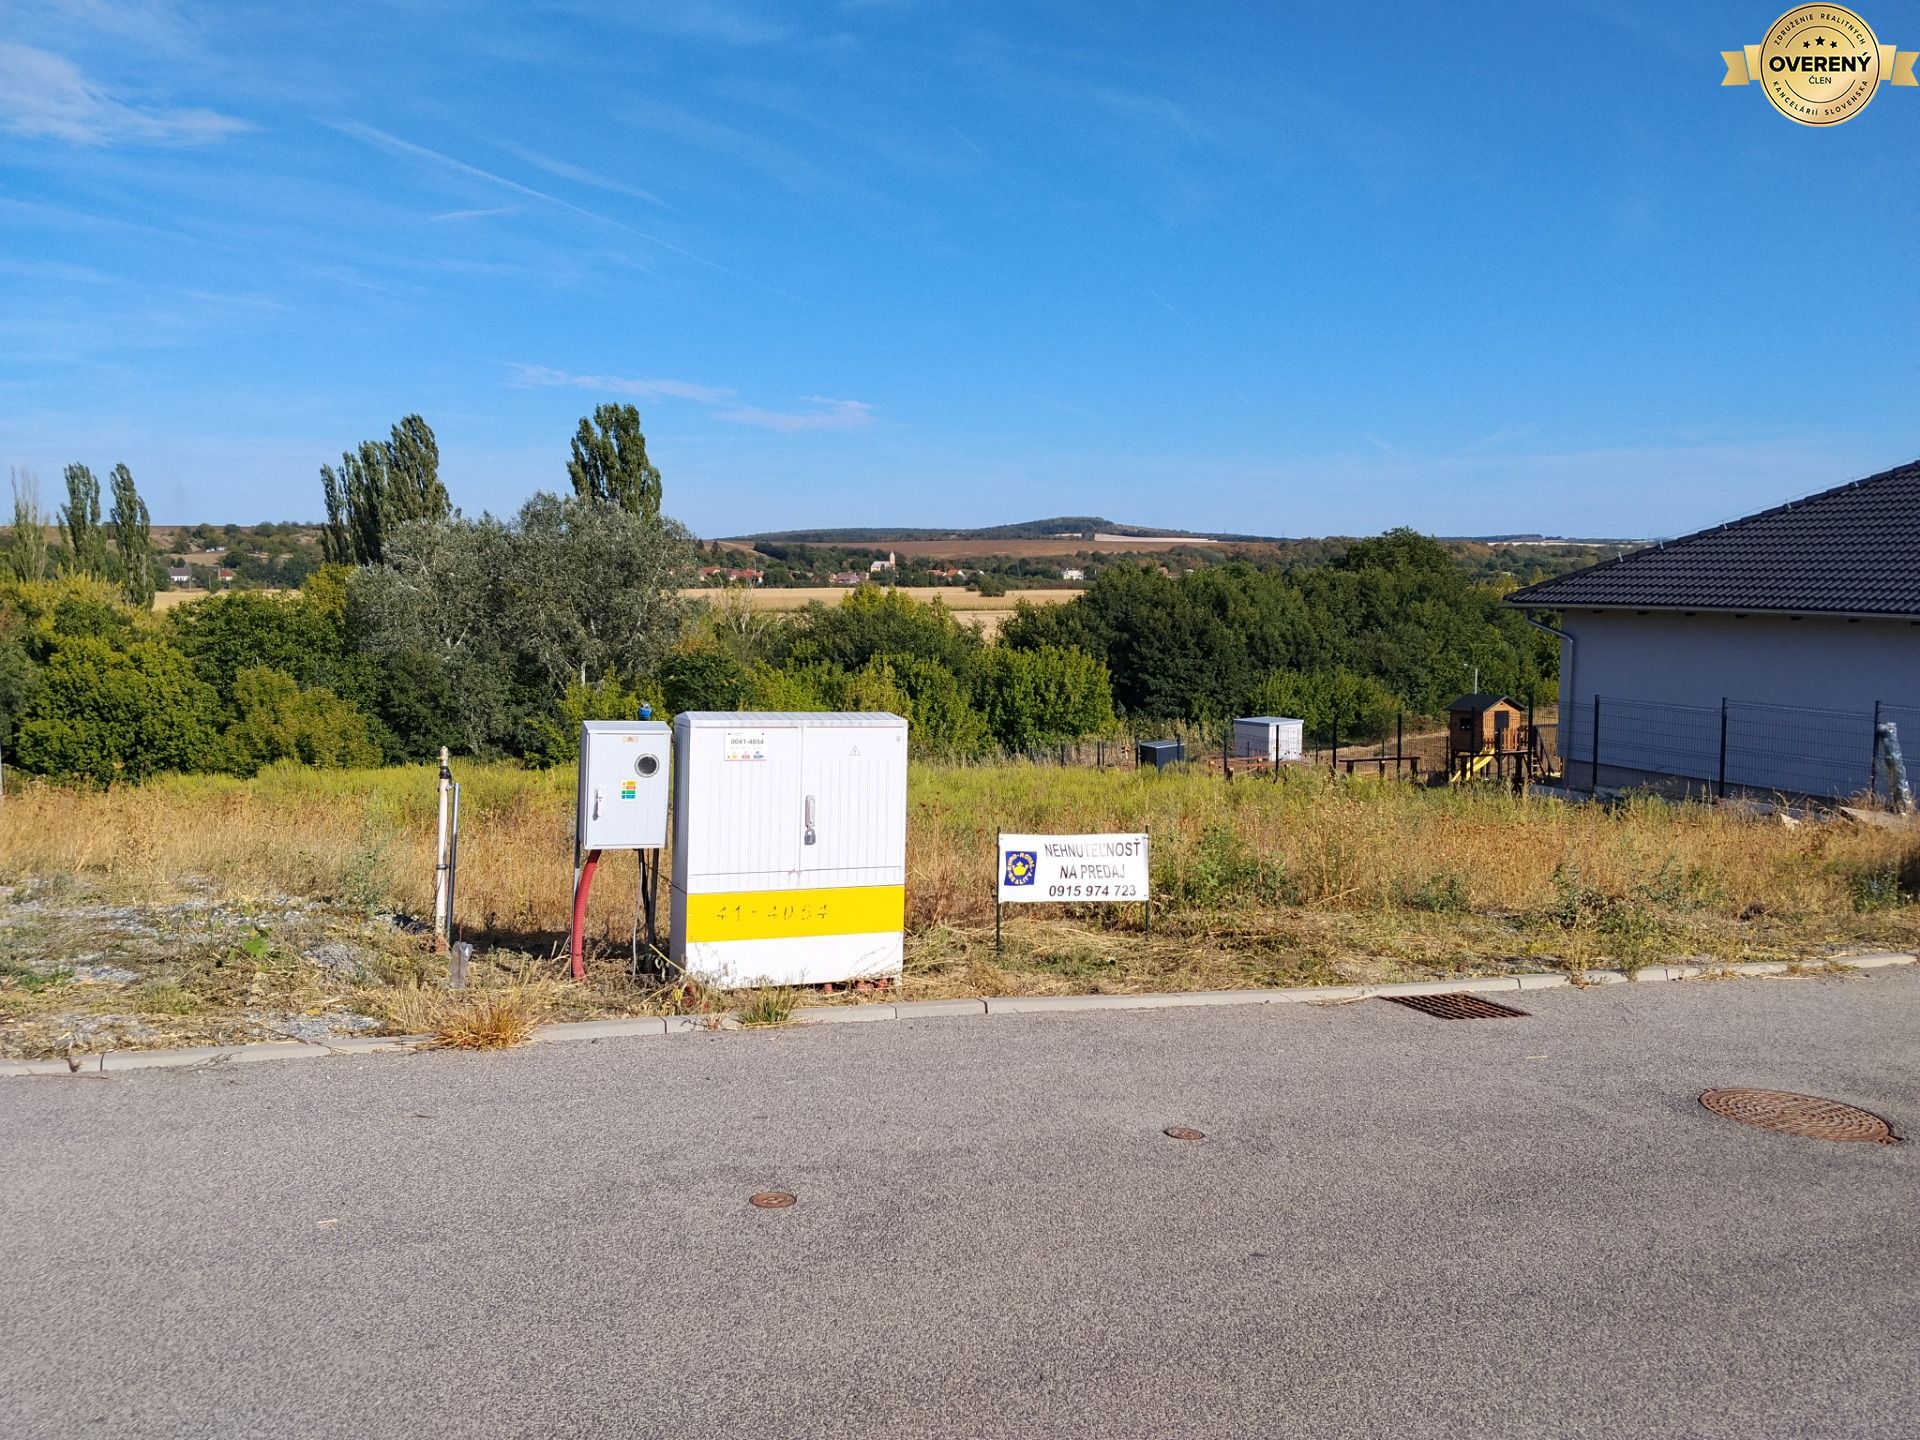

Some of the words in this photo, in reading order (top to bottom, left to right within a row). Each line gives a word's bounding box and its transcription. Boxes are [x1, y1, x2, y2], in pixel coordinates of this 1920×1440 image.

[1060, 865, 1077, 879] NA
[1081, 864, 1125, 879] PREDAJ
[1049, 885, 1081, 897] 0915
[1086, 885, 1109, 897] 974
[1114, 884, 1137, 897] 723
